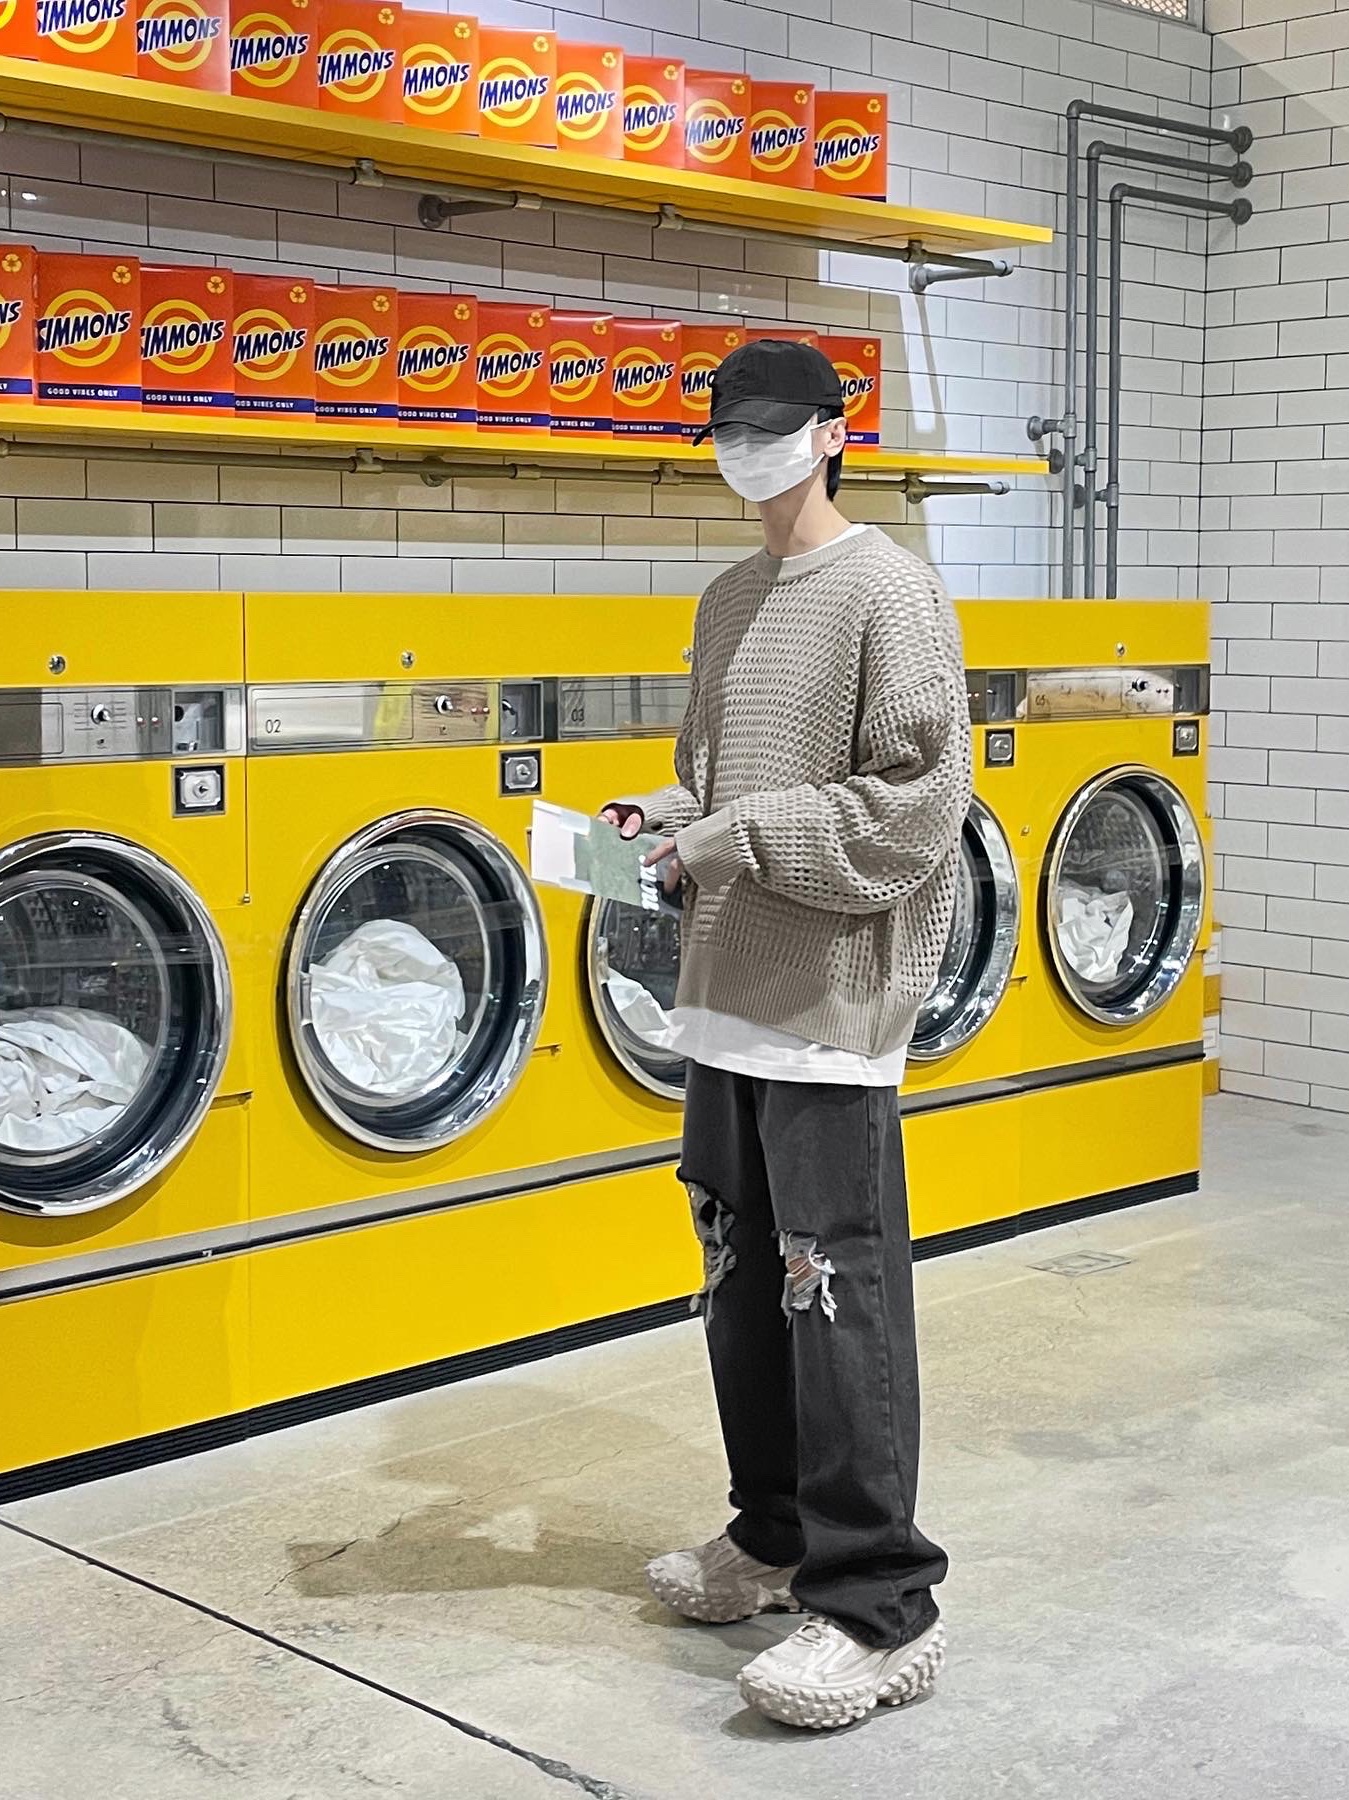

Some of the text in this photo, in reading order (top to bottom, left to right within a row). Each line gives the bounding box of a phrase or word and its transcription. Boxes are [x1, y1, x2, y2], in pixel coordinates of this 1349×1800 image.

[47, 387, 70, 395] GOOD
[97, 389, 118, 397] ONLY
[571, 708, 585, 722] 03
[265, 718, 282, 734] 02
